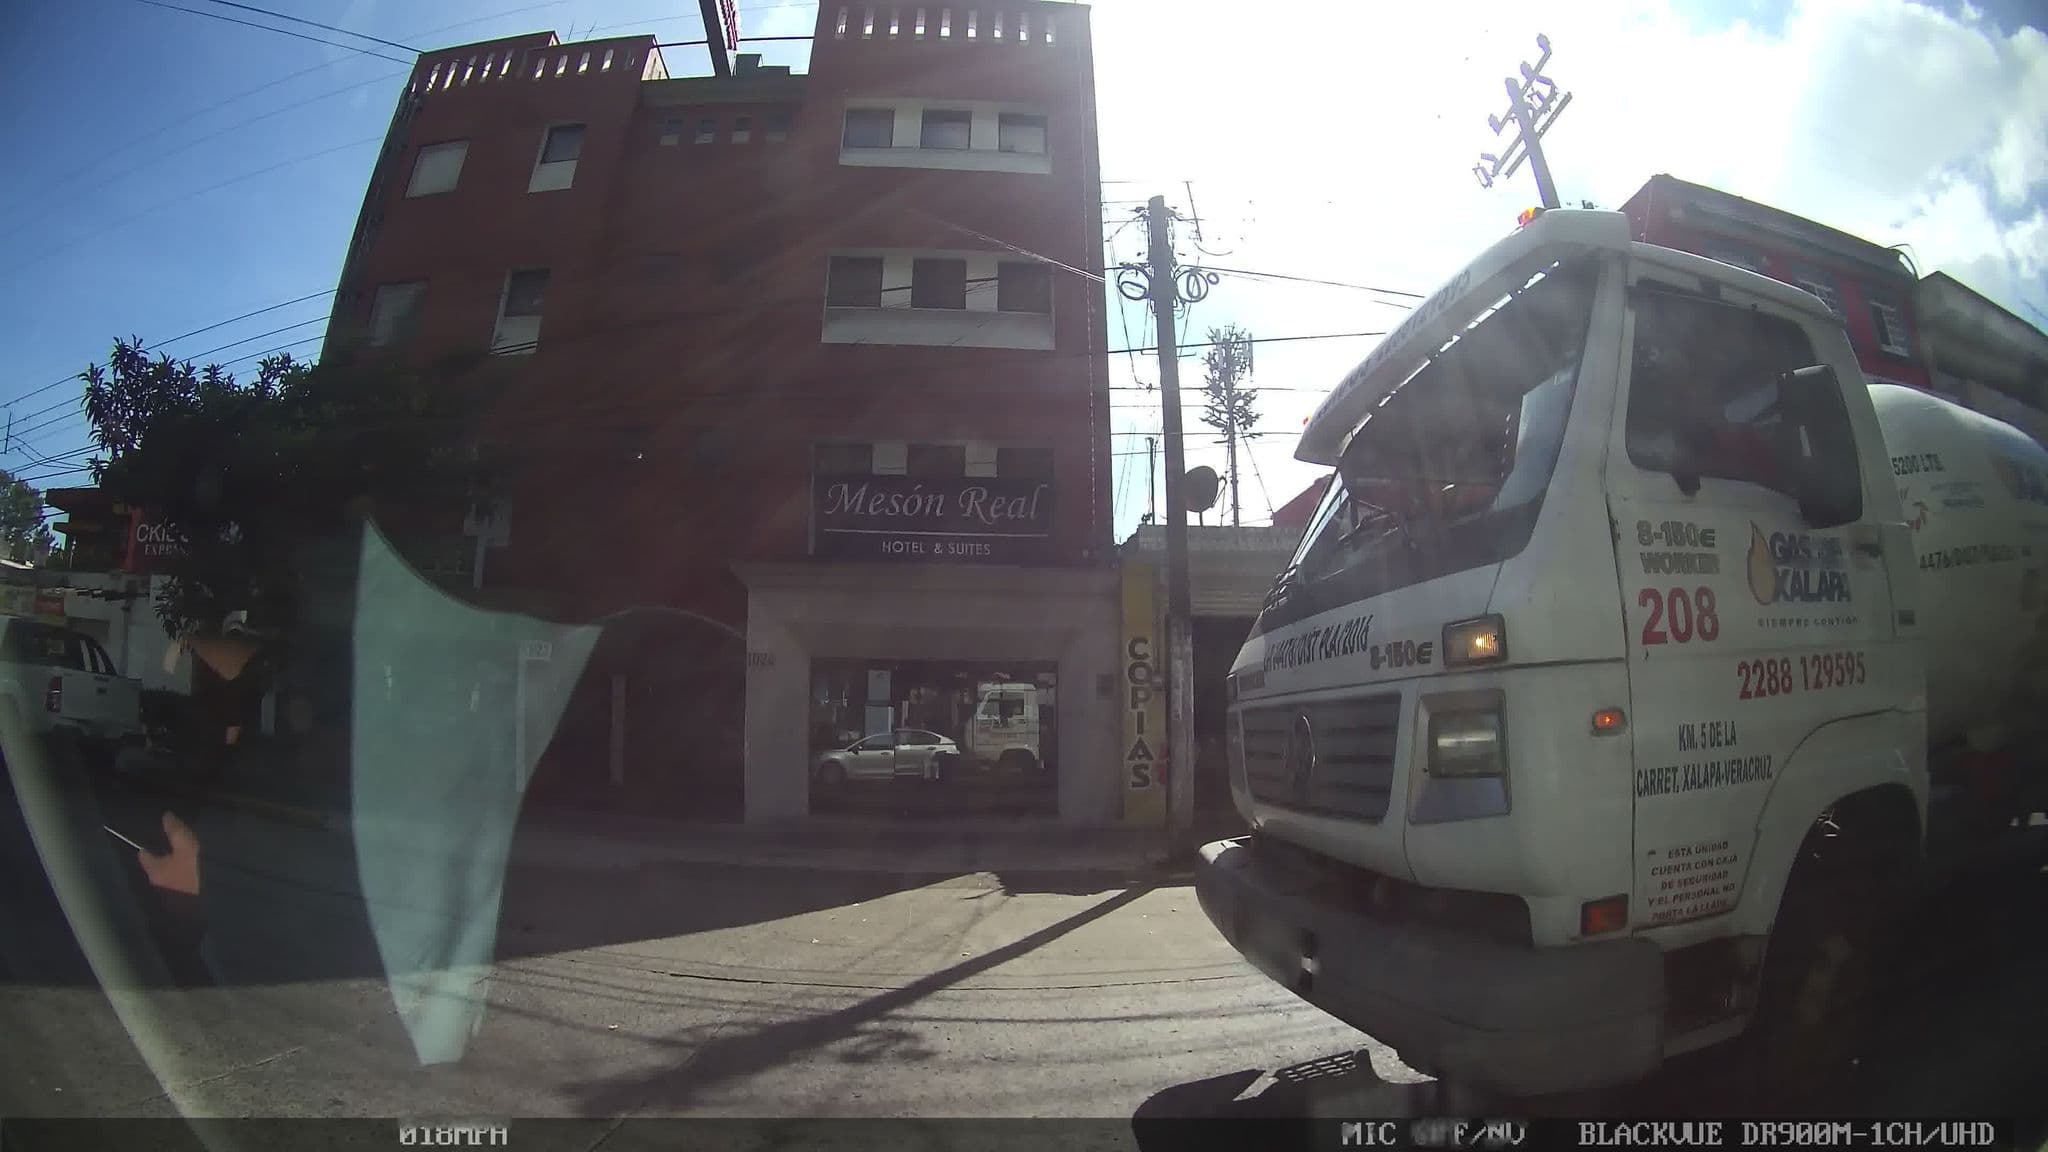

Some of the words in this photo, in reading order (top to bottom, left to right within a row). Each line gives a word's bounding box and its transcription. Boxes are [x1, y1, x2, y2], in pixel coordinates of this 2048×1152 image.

[824, 482, 945, 517] Mesón
[959, 483, 1048, 525] Real
[882, 541, 925, 553] HOTEL
[934, 542, 943, 554] &
[949, 542, 991, 555] SUITES
[1772, 570, 1852, 603] XALAPA
[1638, 586, 1720, 645] 208
[1737, 658, 1793, 700] 2288
[1800, 651, 1866, 690] 129595
[1127, 636, 1154, 788] COPIAS
[1679, 723, 1698, 751] KM.
[1700, 722, 1707, 749] 5
[1709, 721, 1722, 748] DE
[1725, 720, 1737, 747] LA
[1636, 766, 1680, 798] CARRET.
[1682, 754, 1773, 792] XALAPA-VERACRUZ
[1651, 862, 1692, 877] CUENTA
[1694, 858, 1714, 870] CON
